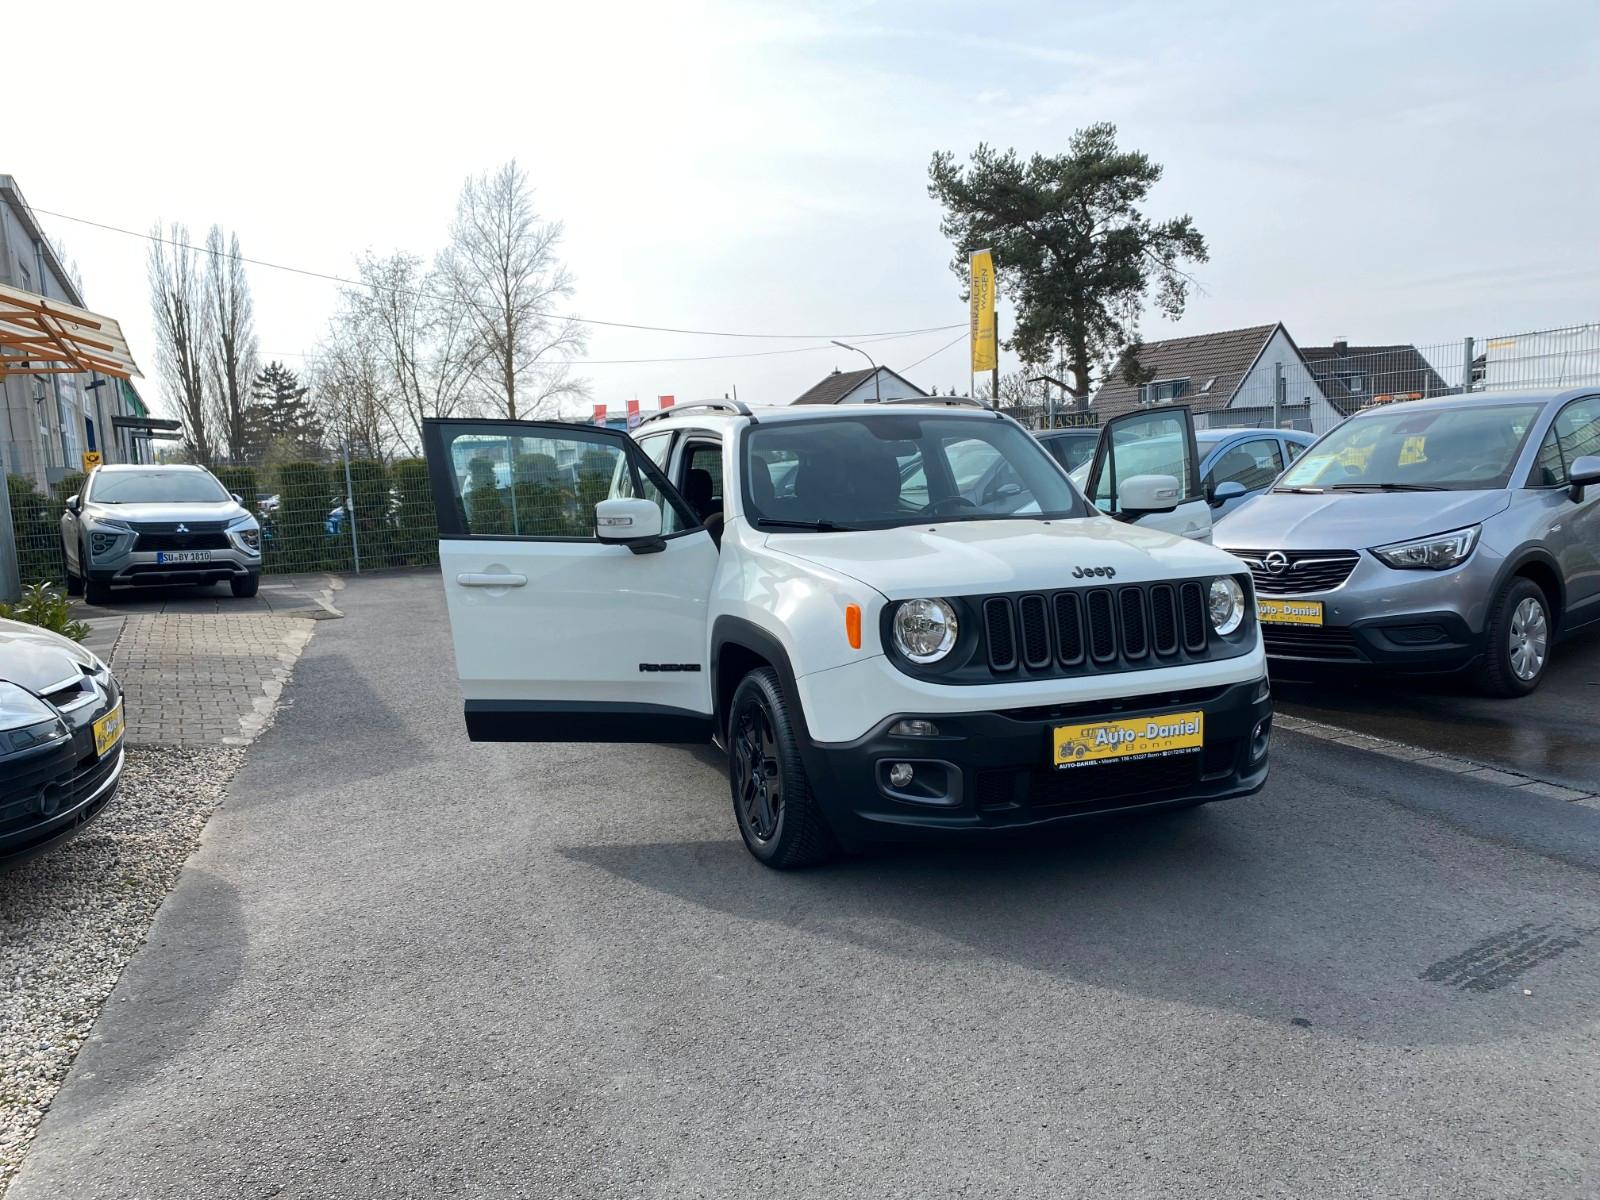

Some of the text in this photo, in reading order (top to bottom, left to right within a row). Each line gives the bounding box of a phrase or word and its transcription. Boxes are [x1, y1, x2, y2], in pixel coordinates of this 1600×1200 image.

[163, 553, 174, 562] SU
[1071, 565, 1117, 580] Jeep
[1125, 740, 1172, 752] Bonn
